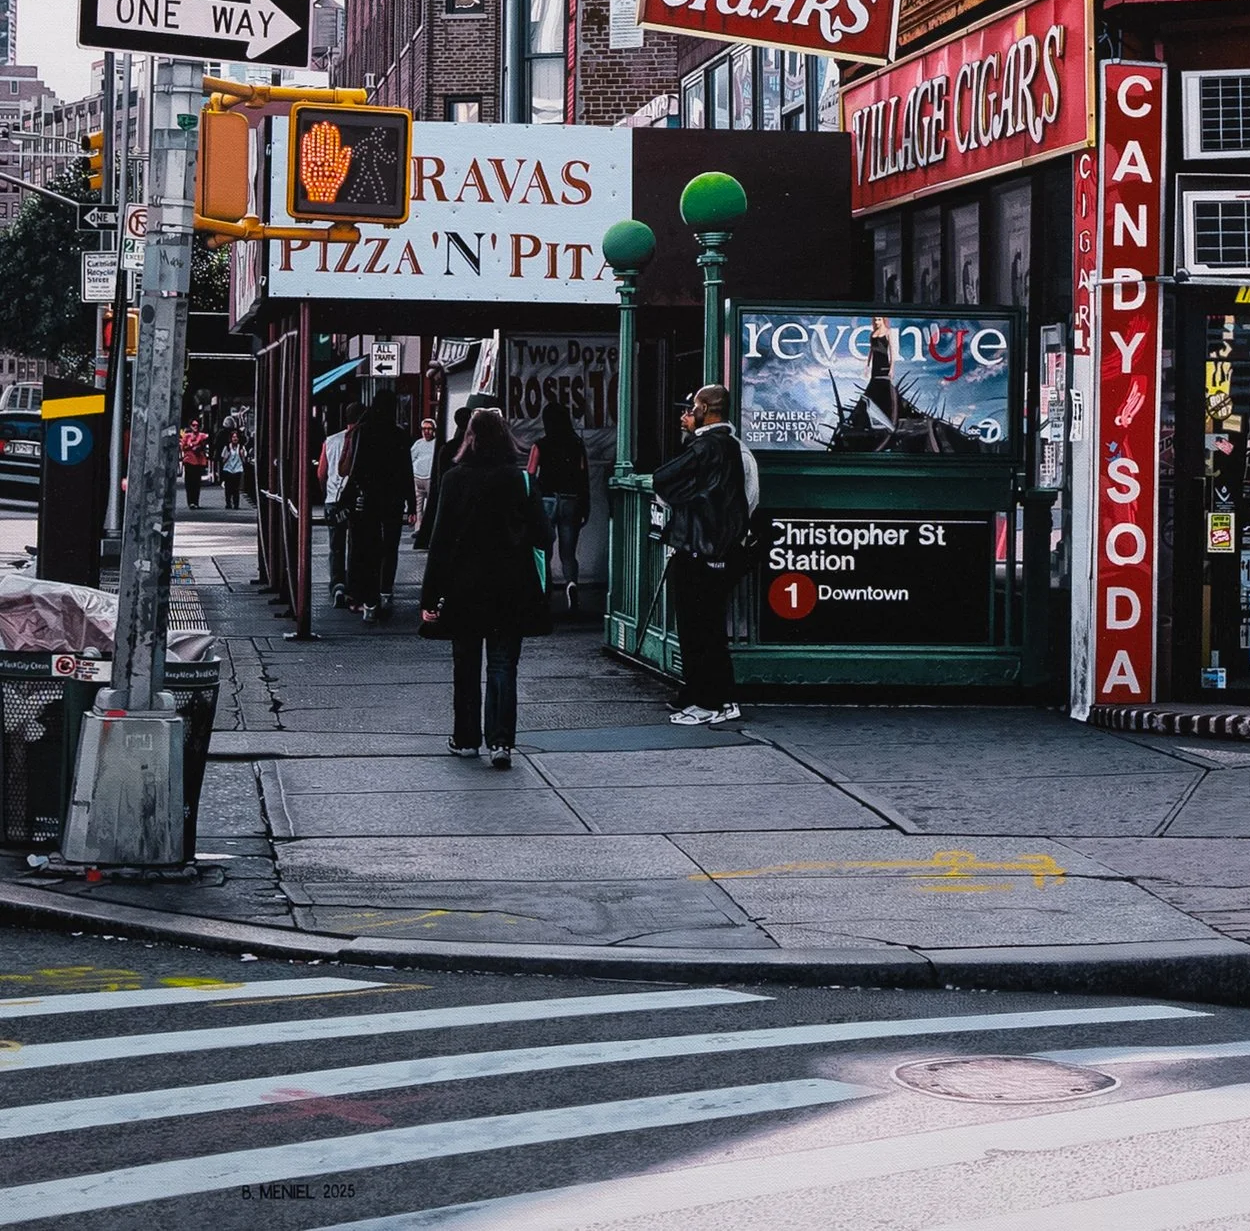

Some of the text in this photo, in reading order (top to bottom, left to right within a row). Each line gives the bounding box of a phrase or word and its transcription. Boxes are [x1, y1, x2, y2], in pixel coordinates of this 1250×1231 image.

[212, 5, 276, 39] WAY
[852, 25, 1065, 186] VILLAGE CIGARS
[411, 156, 592, 205] RAVAS
[89, 213, 109, 223] ONE
[1110, 75, 1153, 373] CANDY
[279, 231, 424, 275] PIZZA
[431, 231, 498, 277] 'N'
[1078, 154, 1091, 327] CIGAR
[376, 345, 392, 353] ALL
[512, 340, 619, 365] Two Doze
[744, 317, 1008, 382] revenge
[750, 421, 820, 431] WEDNESDAY
[753, 410, 817, 421] PREMIERES
[61, 426, 83, 461] P
[746, 431, 822, 442] SEPT 21 10PM
[771, 522, 947, 550] Christopher St
[769, 549, 855, 571] Station
[1102, 458, 1146, 695] SODA
[784, 582, 909, 608] 1 Downtown
[242, 1184, 356, 1200] B. MENIEL 2025
